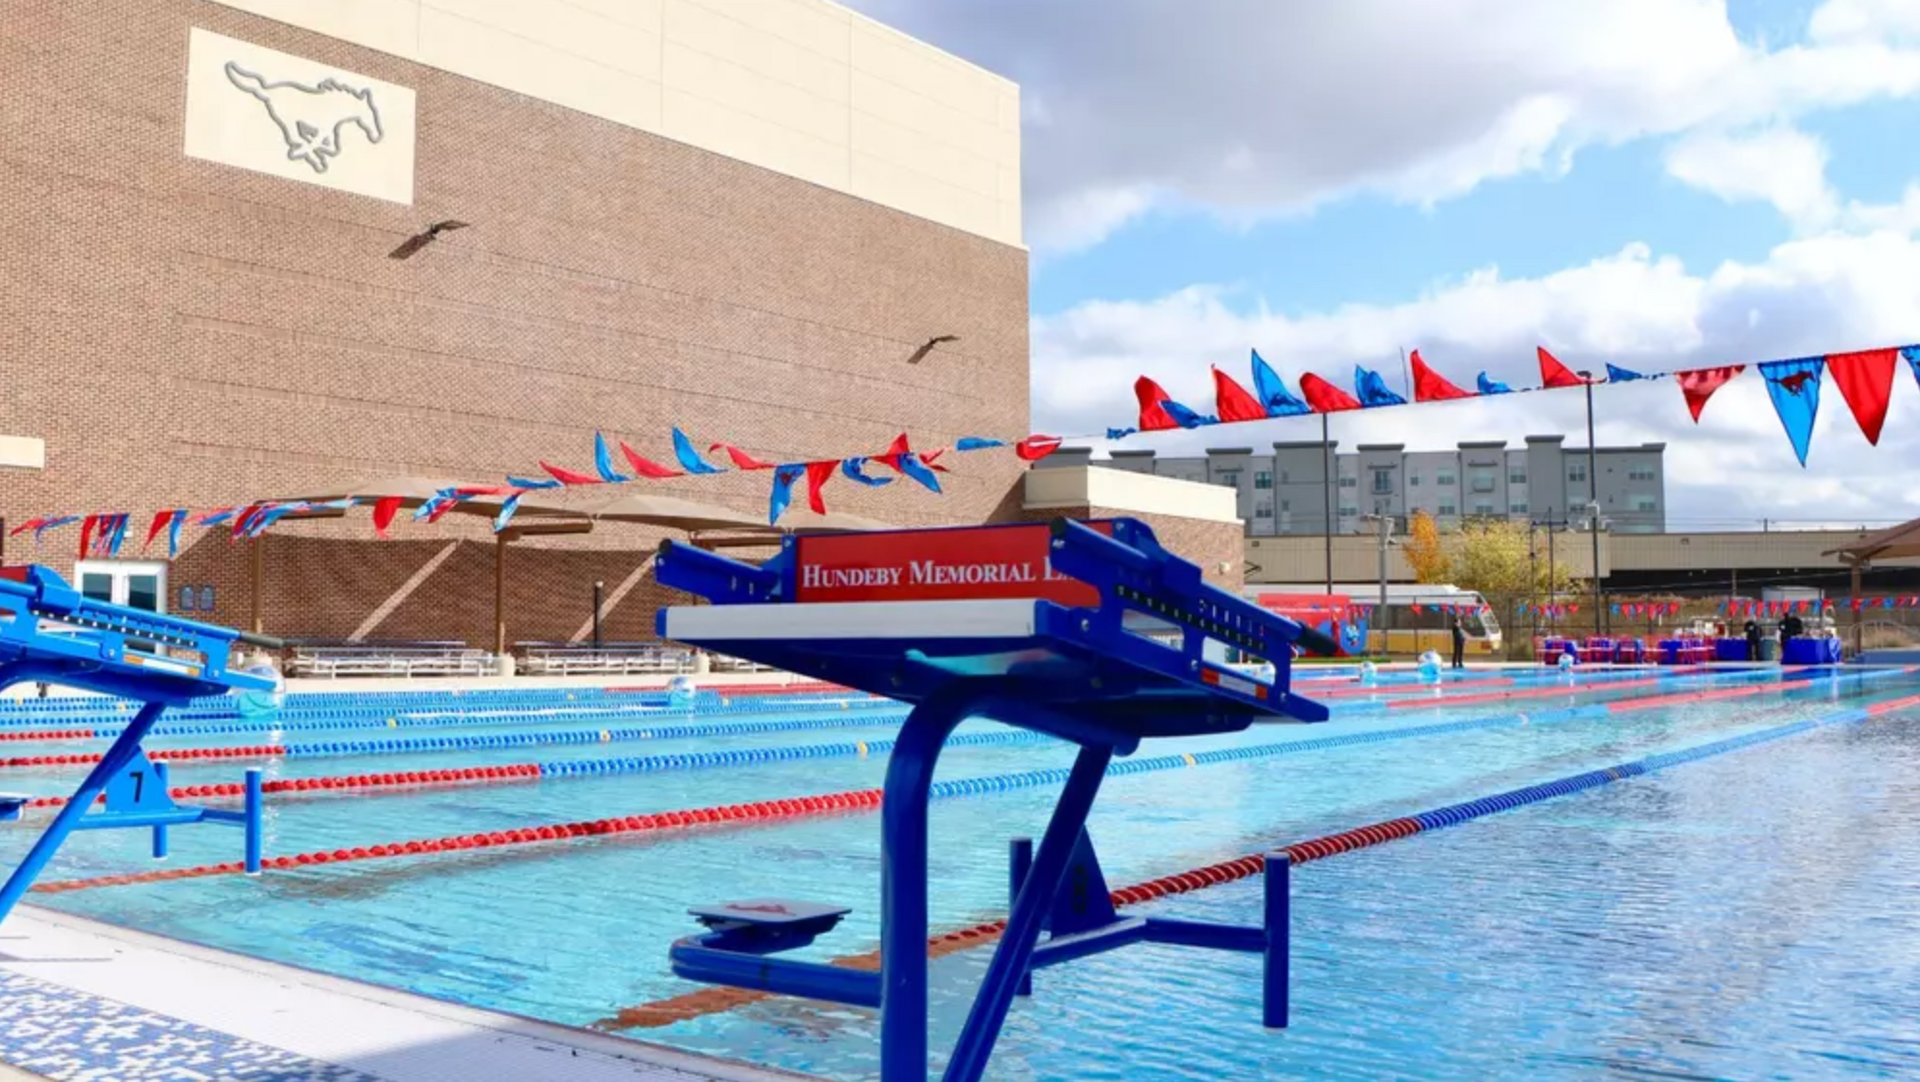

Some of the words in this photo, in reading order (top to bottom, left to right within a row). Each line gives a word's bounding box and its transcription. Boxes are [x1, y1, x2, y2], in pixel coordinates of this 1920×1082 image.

[802, 563, 902, 588] HUNDEBY
[909, 559, 1036, 585] MEMORIAL
[129, 771, 143, 803] 7
